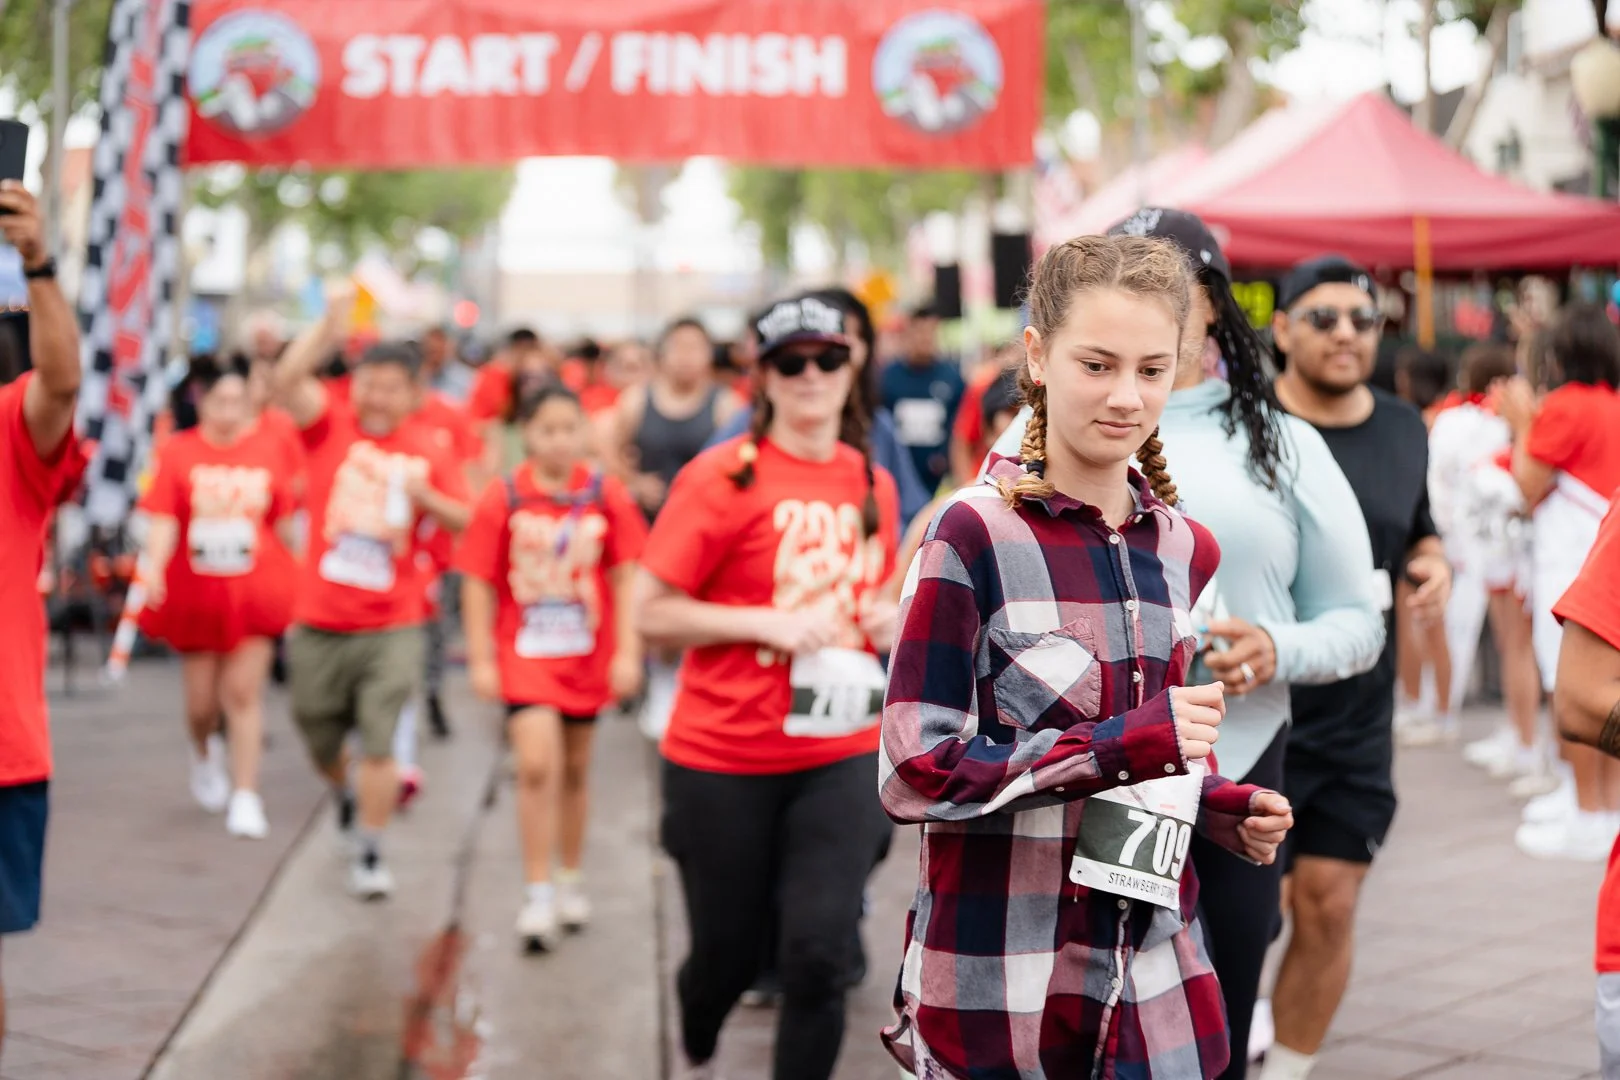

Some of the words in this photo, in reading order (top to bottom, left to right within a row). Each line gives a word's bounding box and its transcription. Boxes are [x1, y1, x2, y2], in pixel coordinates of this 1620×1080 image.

[340, 32, 560, 99] START
[564, 31, 604, 93] /
[610, 31, 848, 98] FINISH
[1118, 808, 1192, 880] 709
